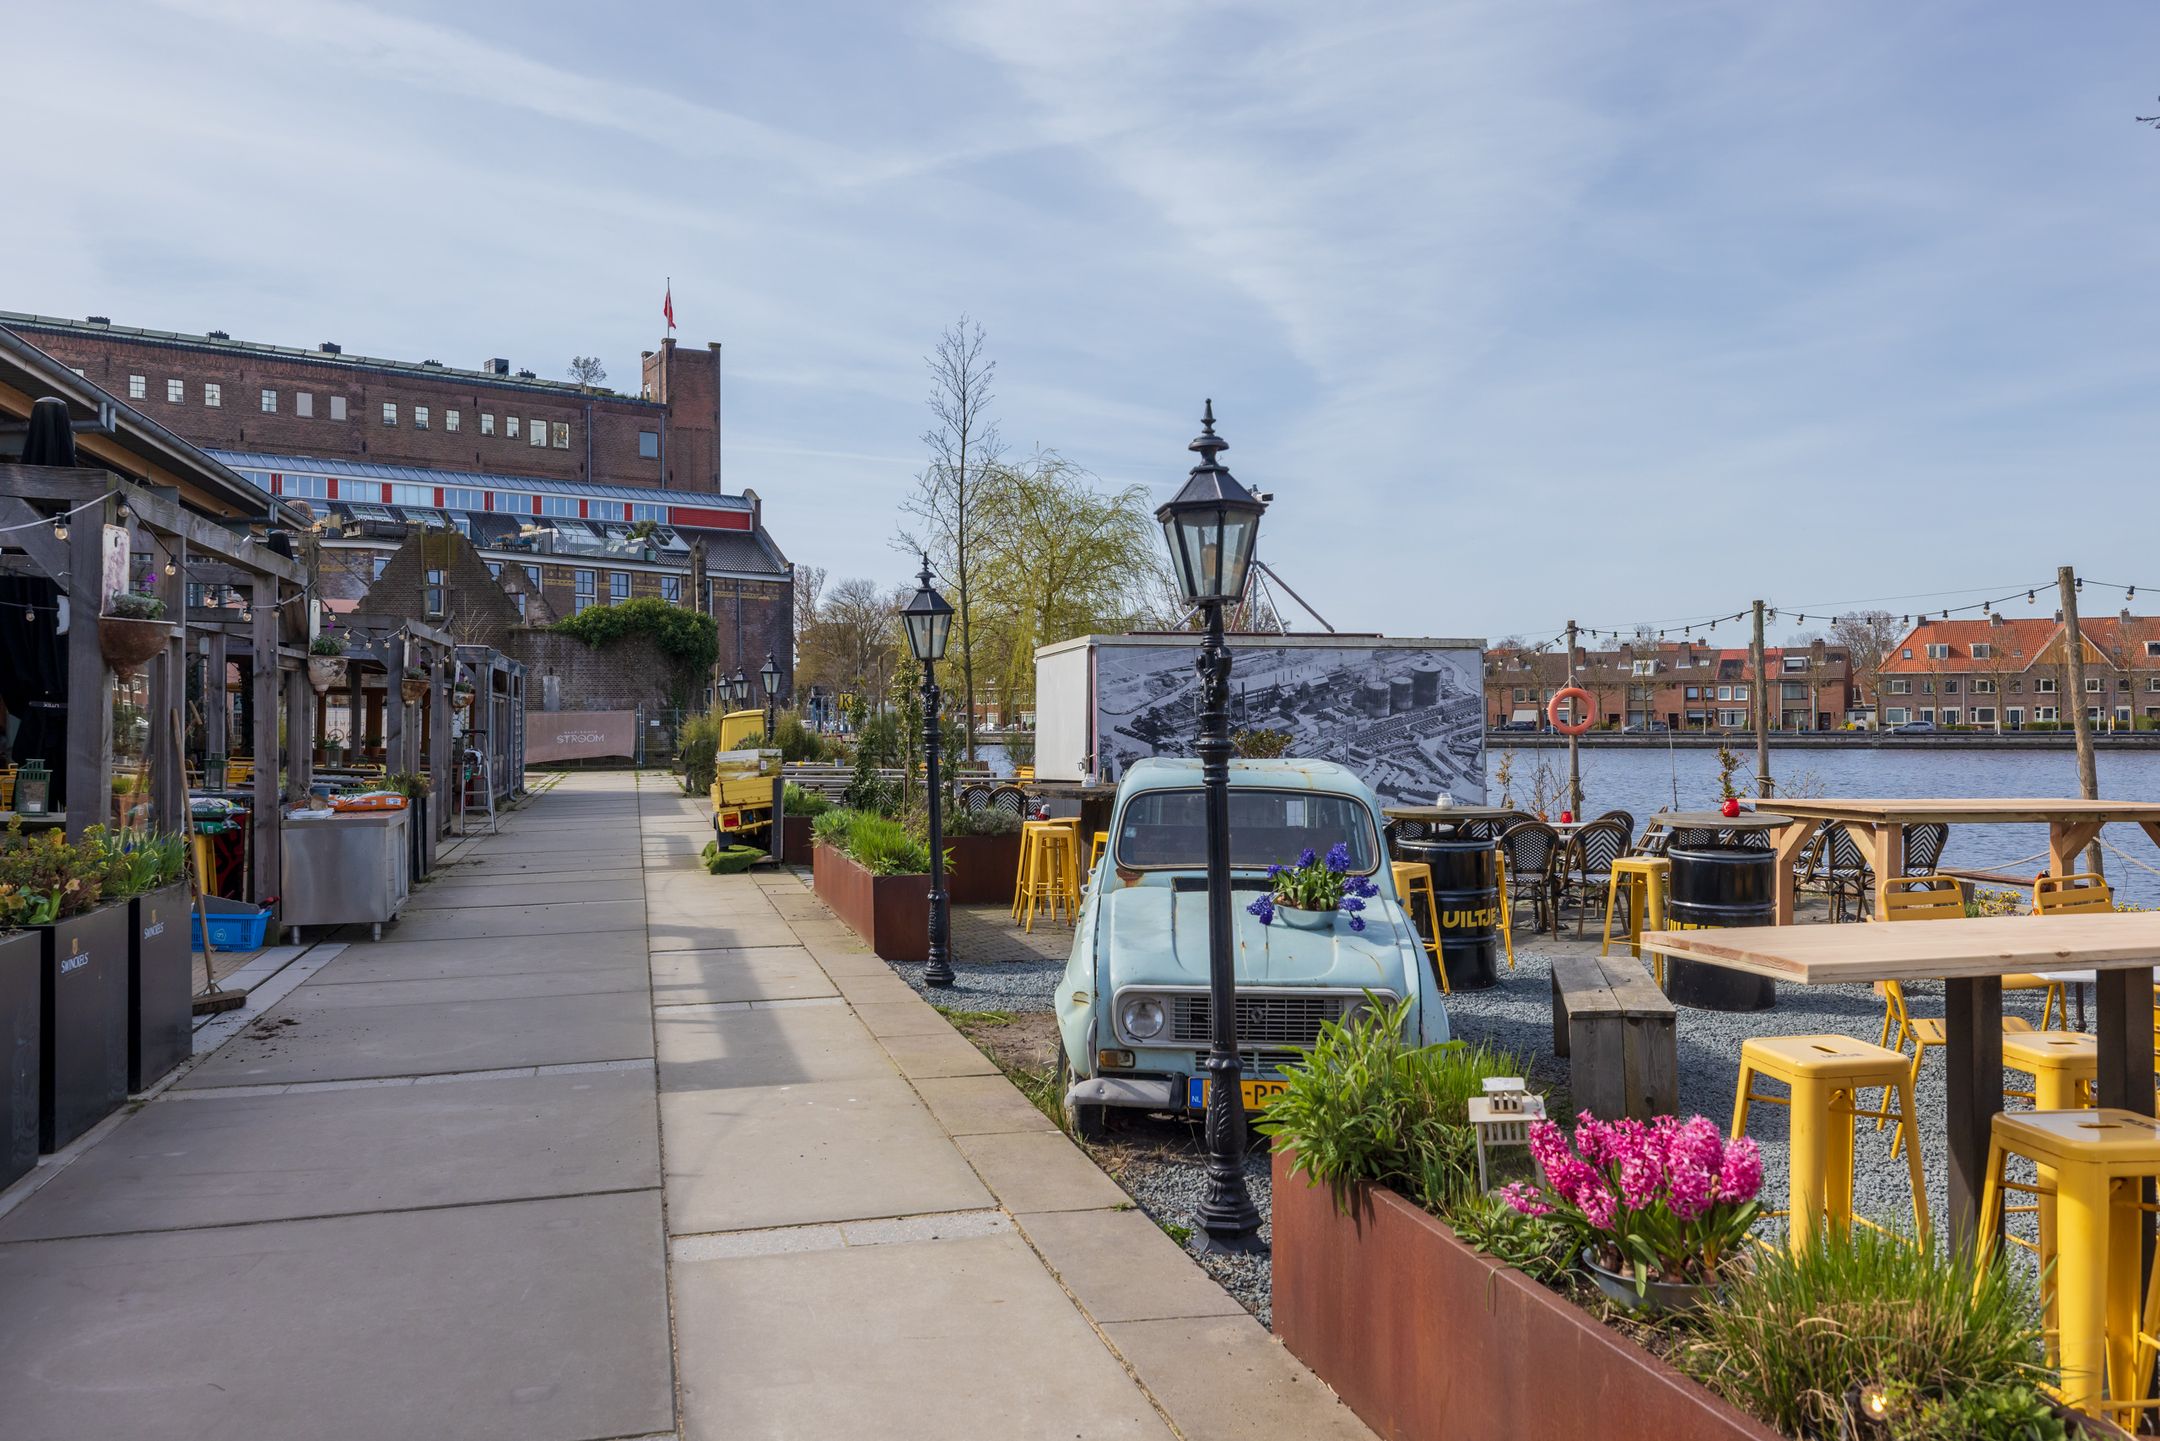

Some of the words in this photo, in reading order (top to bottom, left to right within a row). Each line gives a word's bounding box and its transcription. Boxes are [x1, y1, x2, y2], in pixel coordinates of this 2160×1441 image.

[556, 733, 605, 745] STROOM
[1442, 907, 1497, 929] UILTJE
[1191, 1095, 1201, 1104] NL
